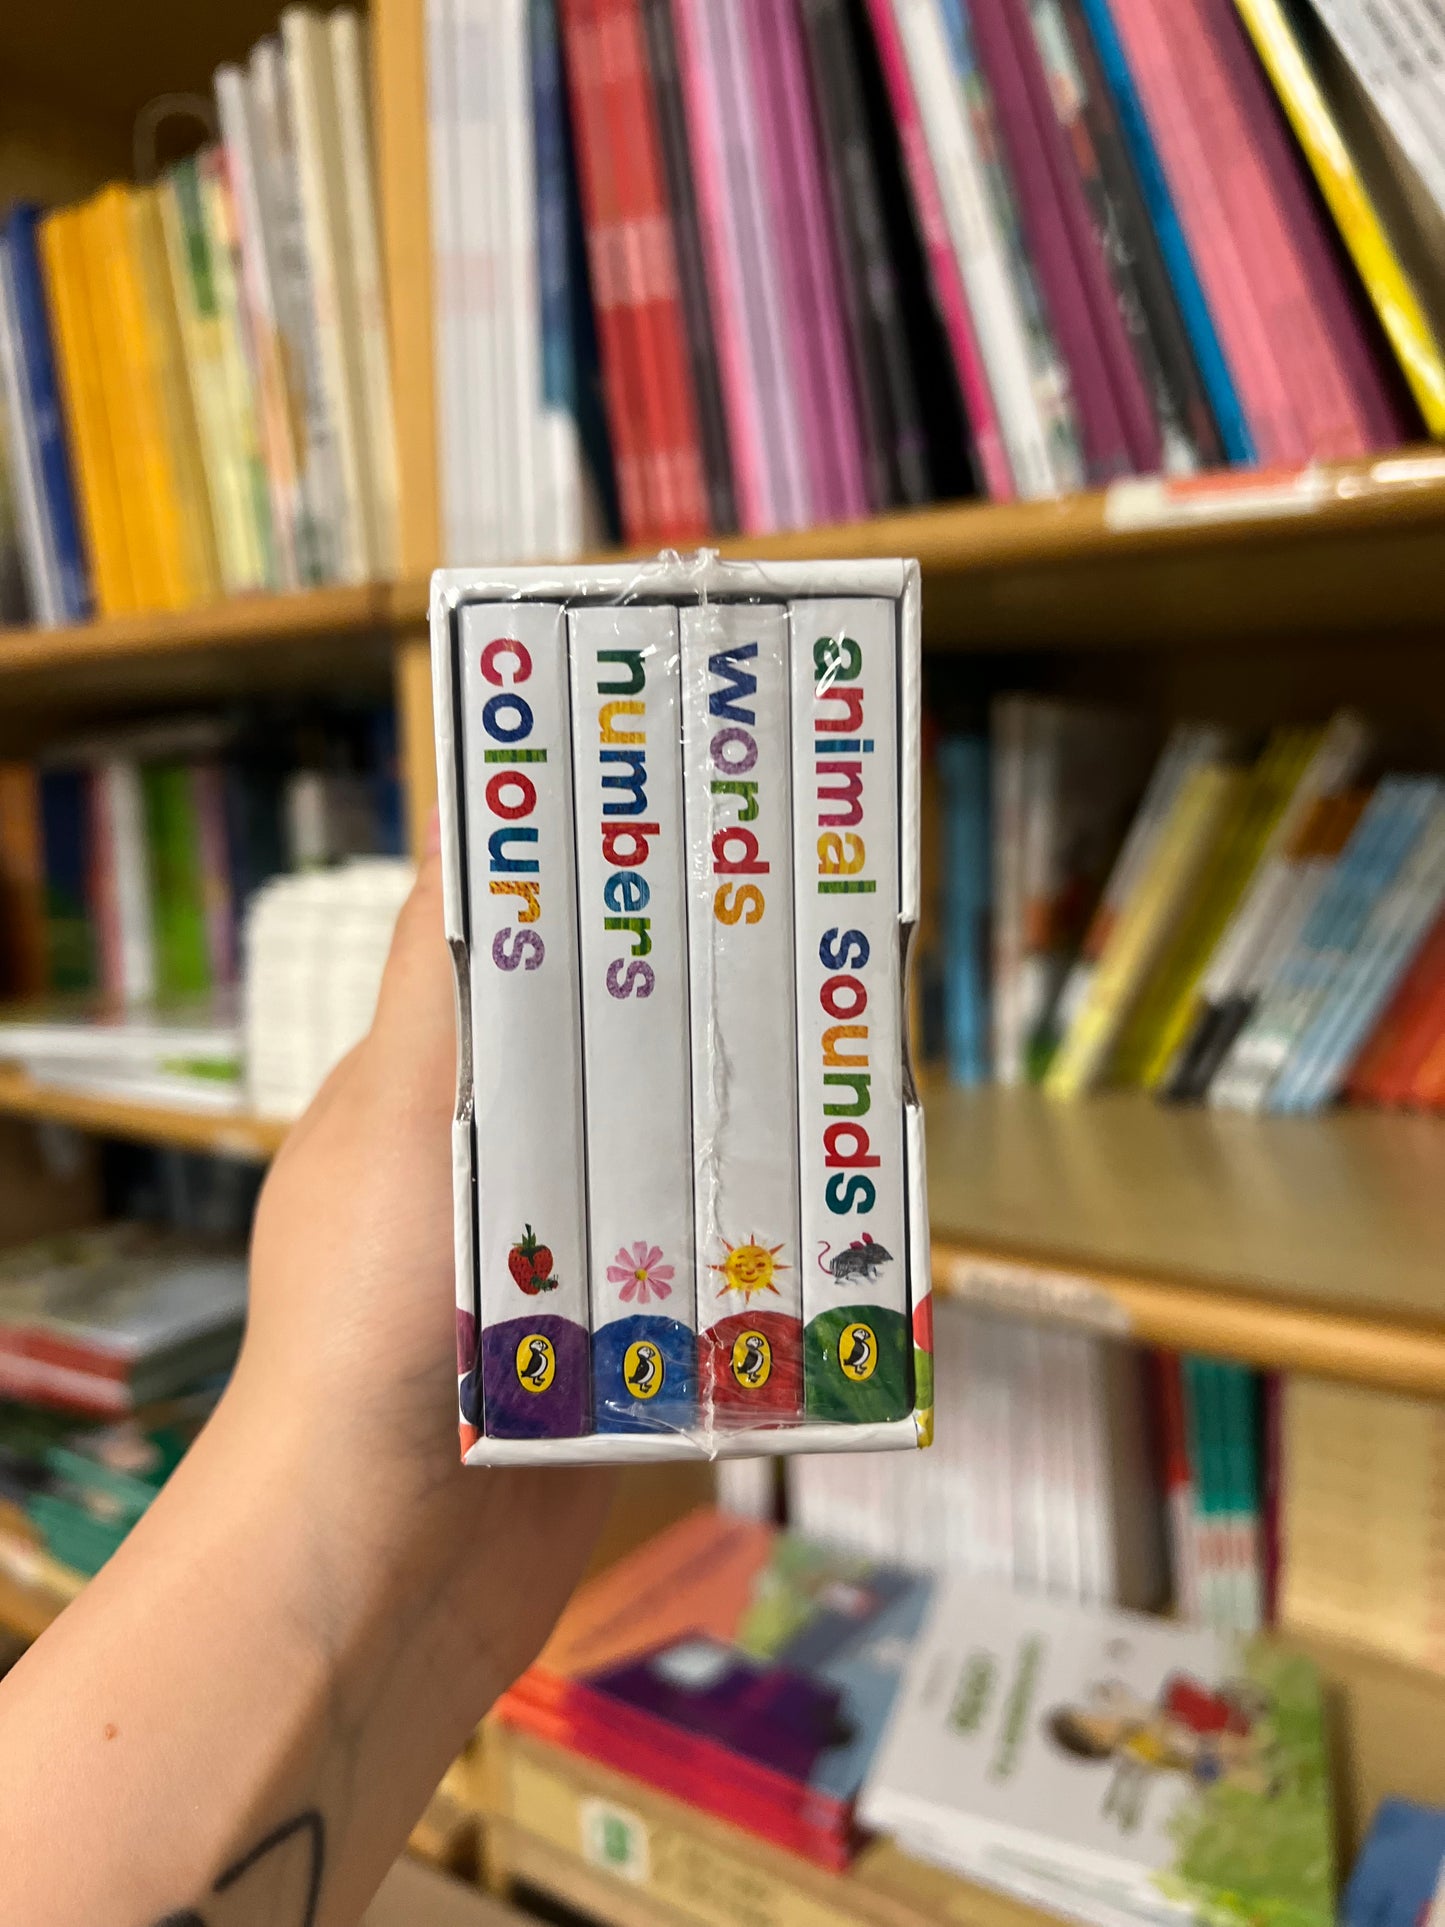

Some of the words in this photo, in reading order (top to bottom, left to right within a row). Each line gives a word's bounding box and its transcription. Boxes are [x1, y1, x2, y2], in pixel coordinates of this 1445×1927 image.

[480, 637, 547, 972] colours
[596, 648, 661, 1000] numbers
[708, 642, 770, 926] words
[812, 635, 877, 895] animal
[818, 926, 881, 1215] sounds
